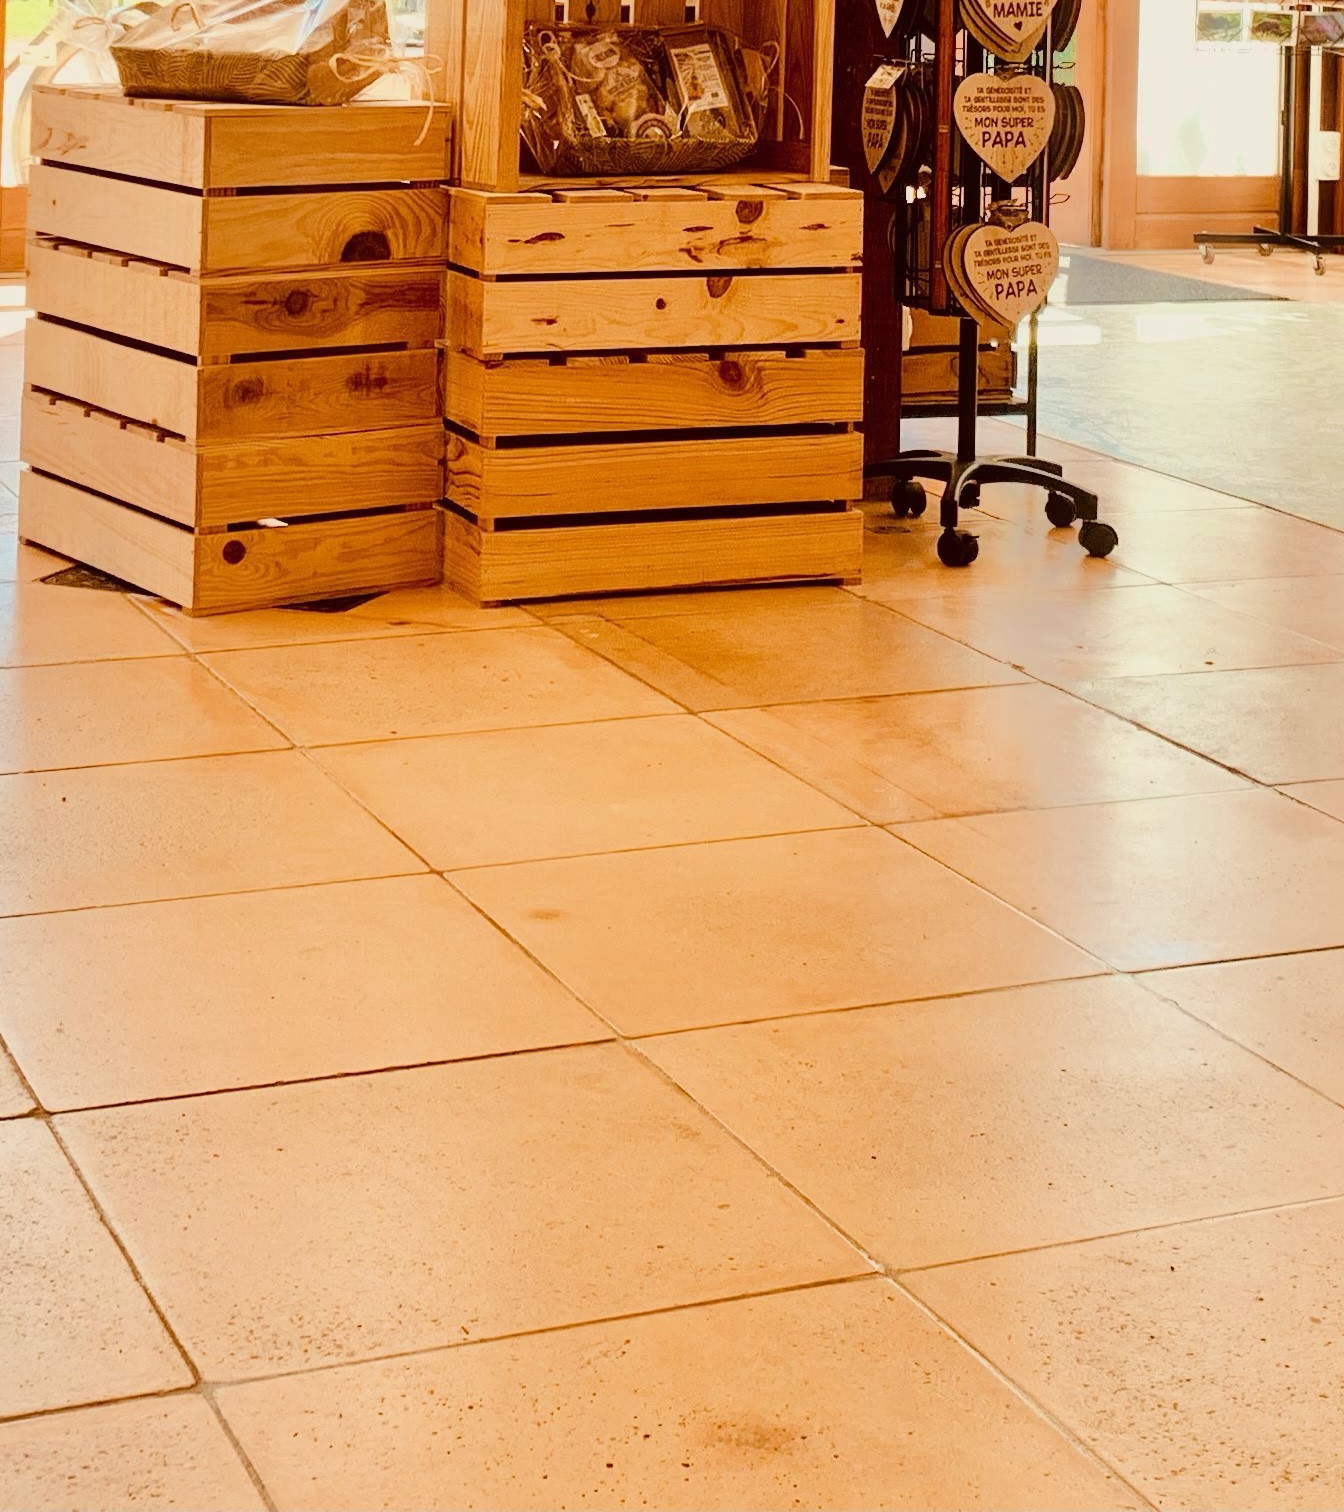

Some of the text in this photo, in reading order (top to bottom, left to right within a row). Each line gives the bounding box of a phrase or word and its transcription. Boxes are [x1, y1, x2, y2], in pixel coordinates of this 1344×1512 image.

[993, 1, 1043, 19] MAMIE
[1032, 96, 1045, 104] DES
[992, 105, 1010, 113] POUR
[974, 116, 1034, 128] MON SUPER
[982, 130, 1027, 149] PAPA
[1002, 255, 1019, 264] POUR
[986, 264, 1042, 281] MON SUPER
[995, 278, 1038, 301] PAPA
